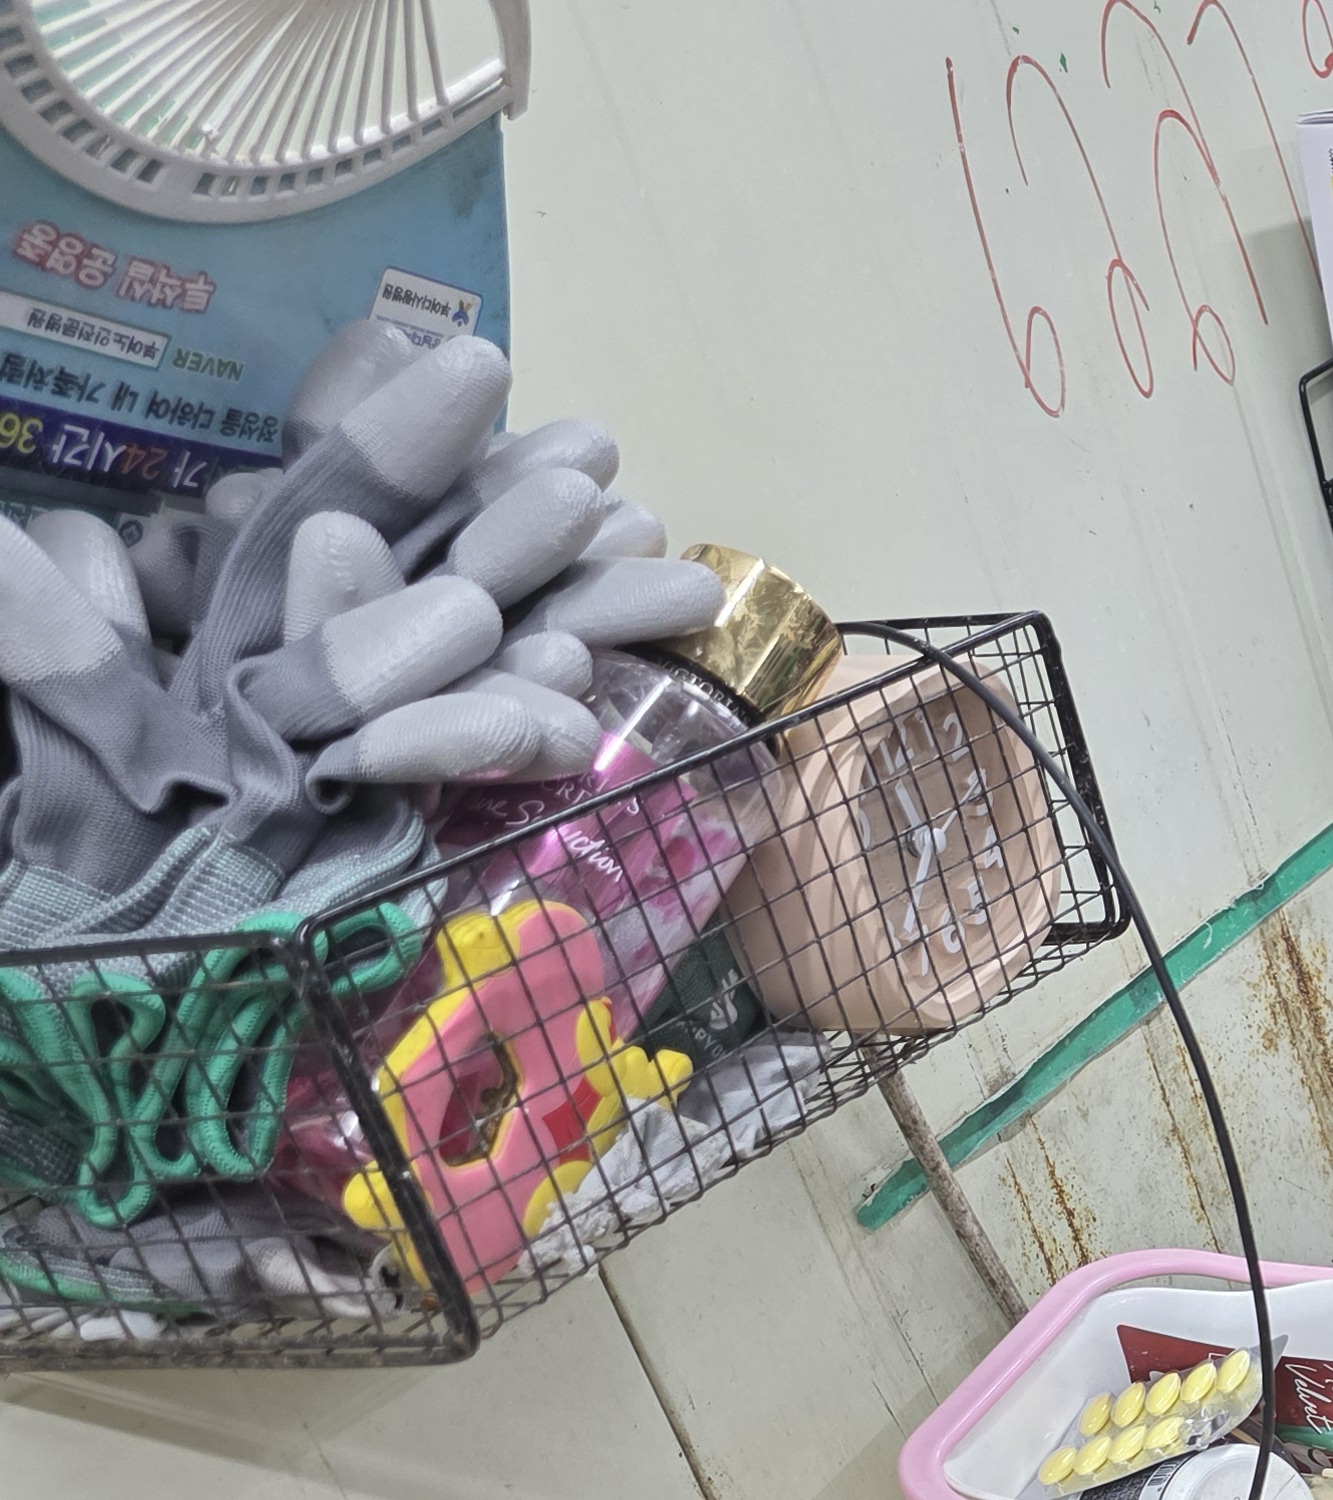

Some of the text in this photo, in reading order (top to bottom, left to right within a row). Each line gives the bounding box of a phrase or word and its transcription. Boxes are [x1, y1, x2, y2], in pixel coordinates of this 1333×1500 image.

[14, 221, 216, 313] 투석실 운영중
[382, 282, 452, 318] 부여다사랑병원
[27, 306, 160, 361] 부여노인전문병원
[172, 347, 246, 381] NAVER
[0, 352, 279, 443] 정성을 다하여 내 가족처럼
[50, 423, 168, 481] 24시간
